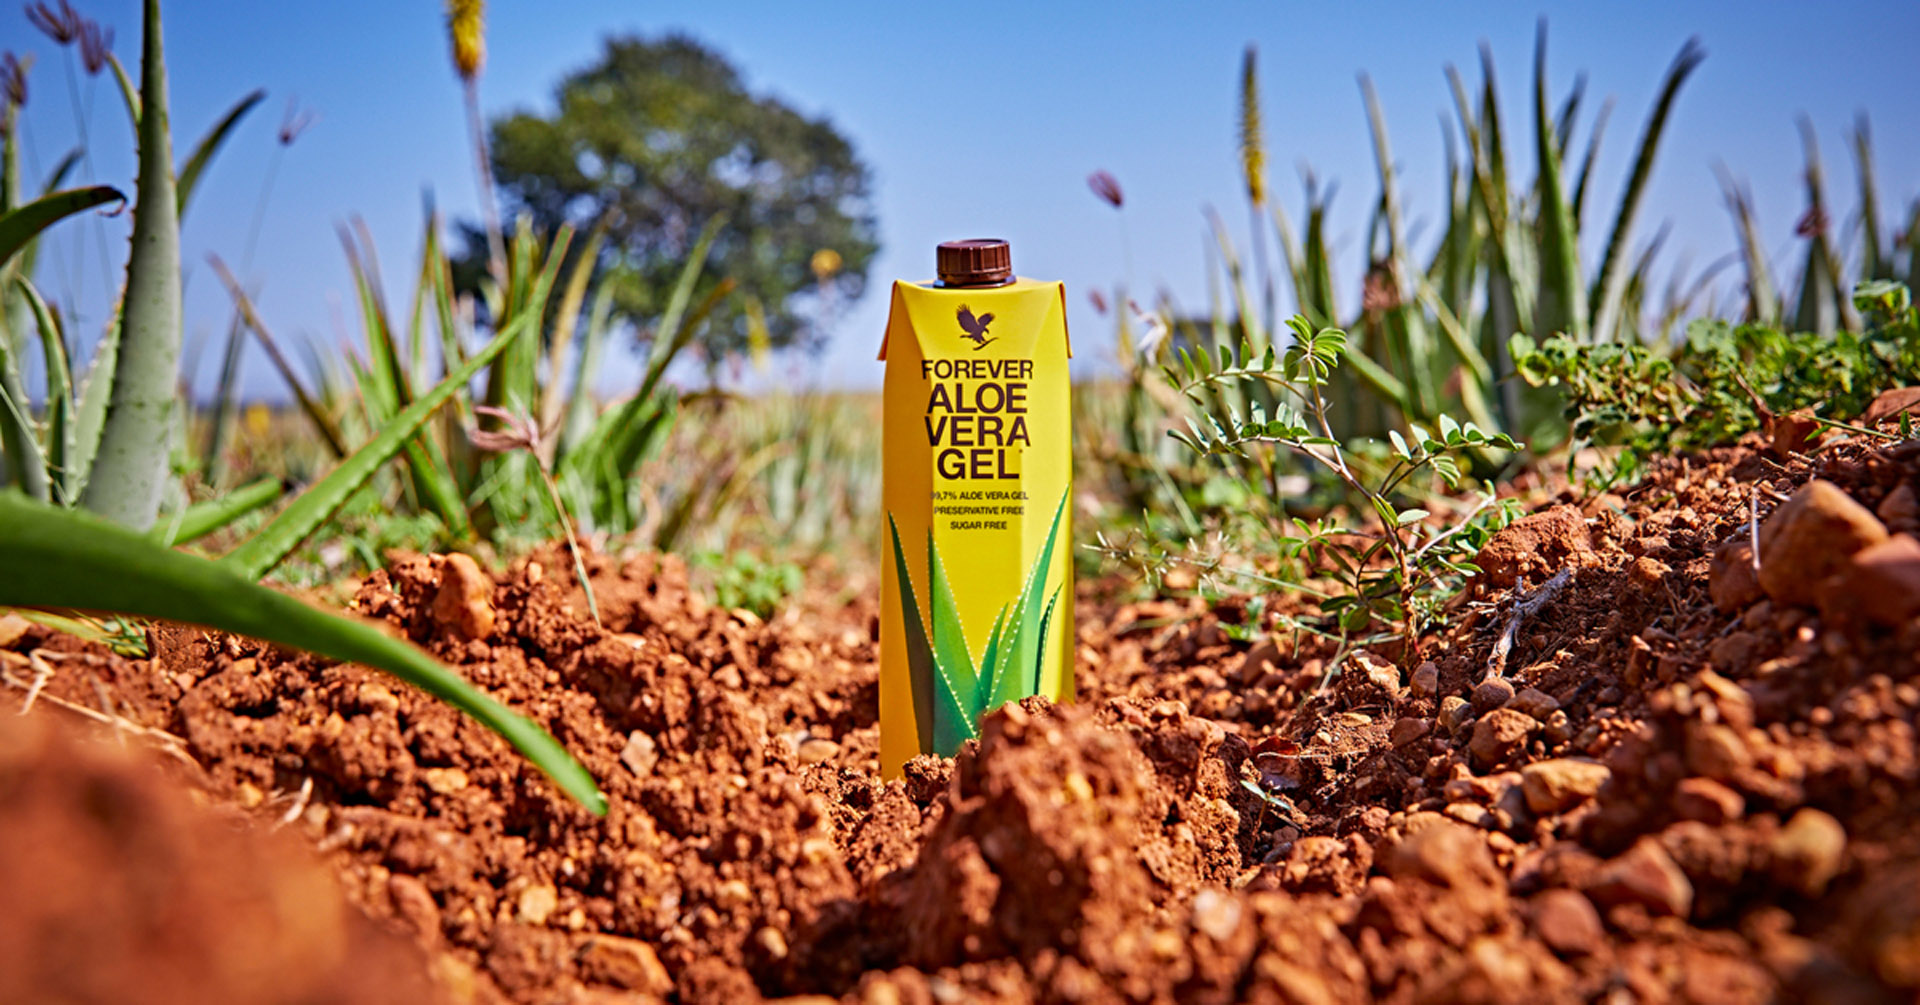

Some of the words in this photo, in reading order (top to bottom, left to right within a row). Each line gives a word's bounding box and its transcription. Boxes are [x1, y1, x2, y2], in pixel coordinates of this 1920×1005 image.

[921, 359, 1033, 380] FOREVER
[927, 382, 1028, 414] ALOE
[924, 416, 1031, 447] VERA
[959, 491, 983, 500] ALOE
[985, 491, 1010, 500] VERA
[1011, 491, 1029, 500] GEL
[934, 506, 999, 515] PRESERVATIVE
[1001, 506, 1025, 515] FREE
[950, 521, 982, 530] SUGAR
[984, 521, 1007, 530] FREE
